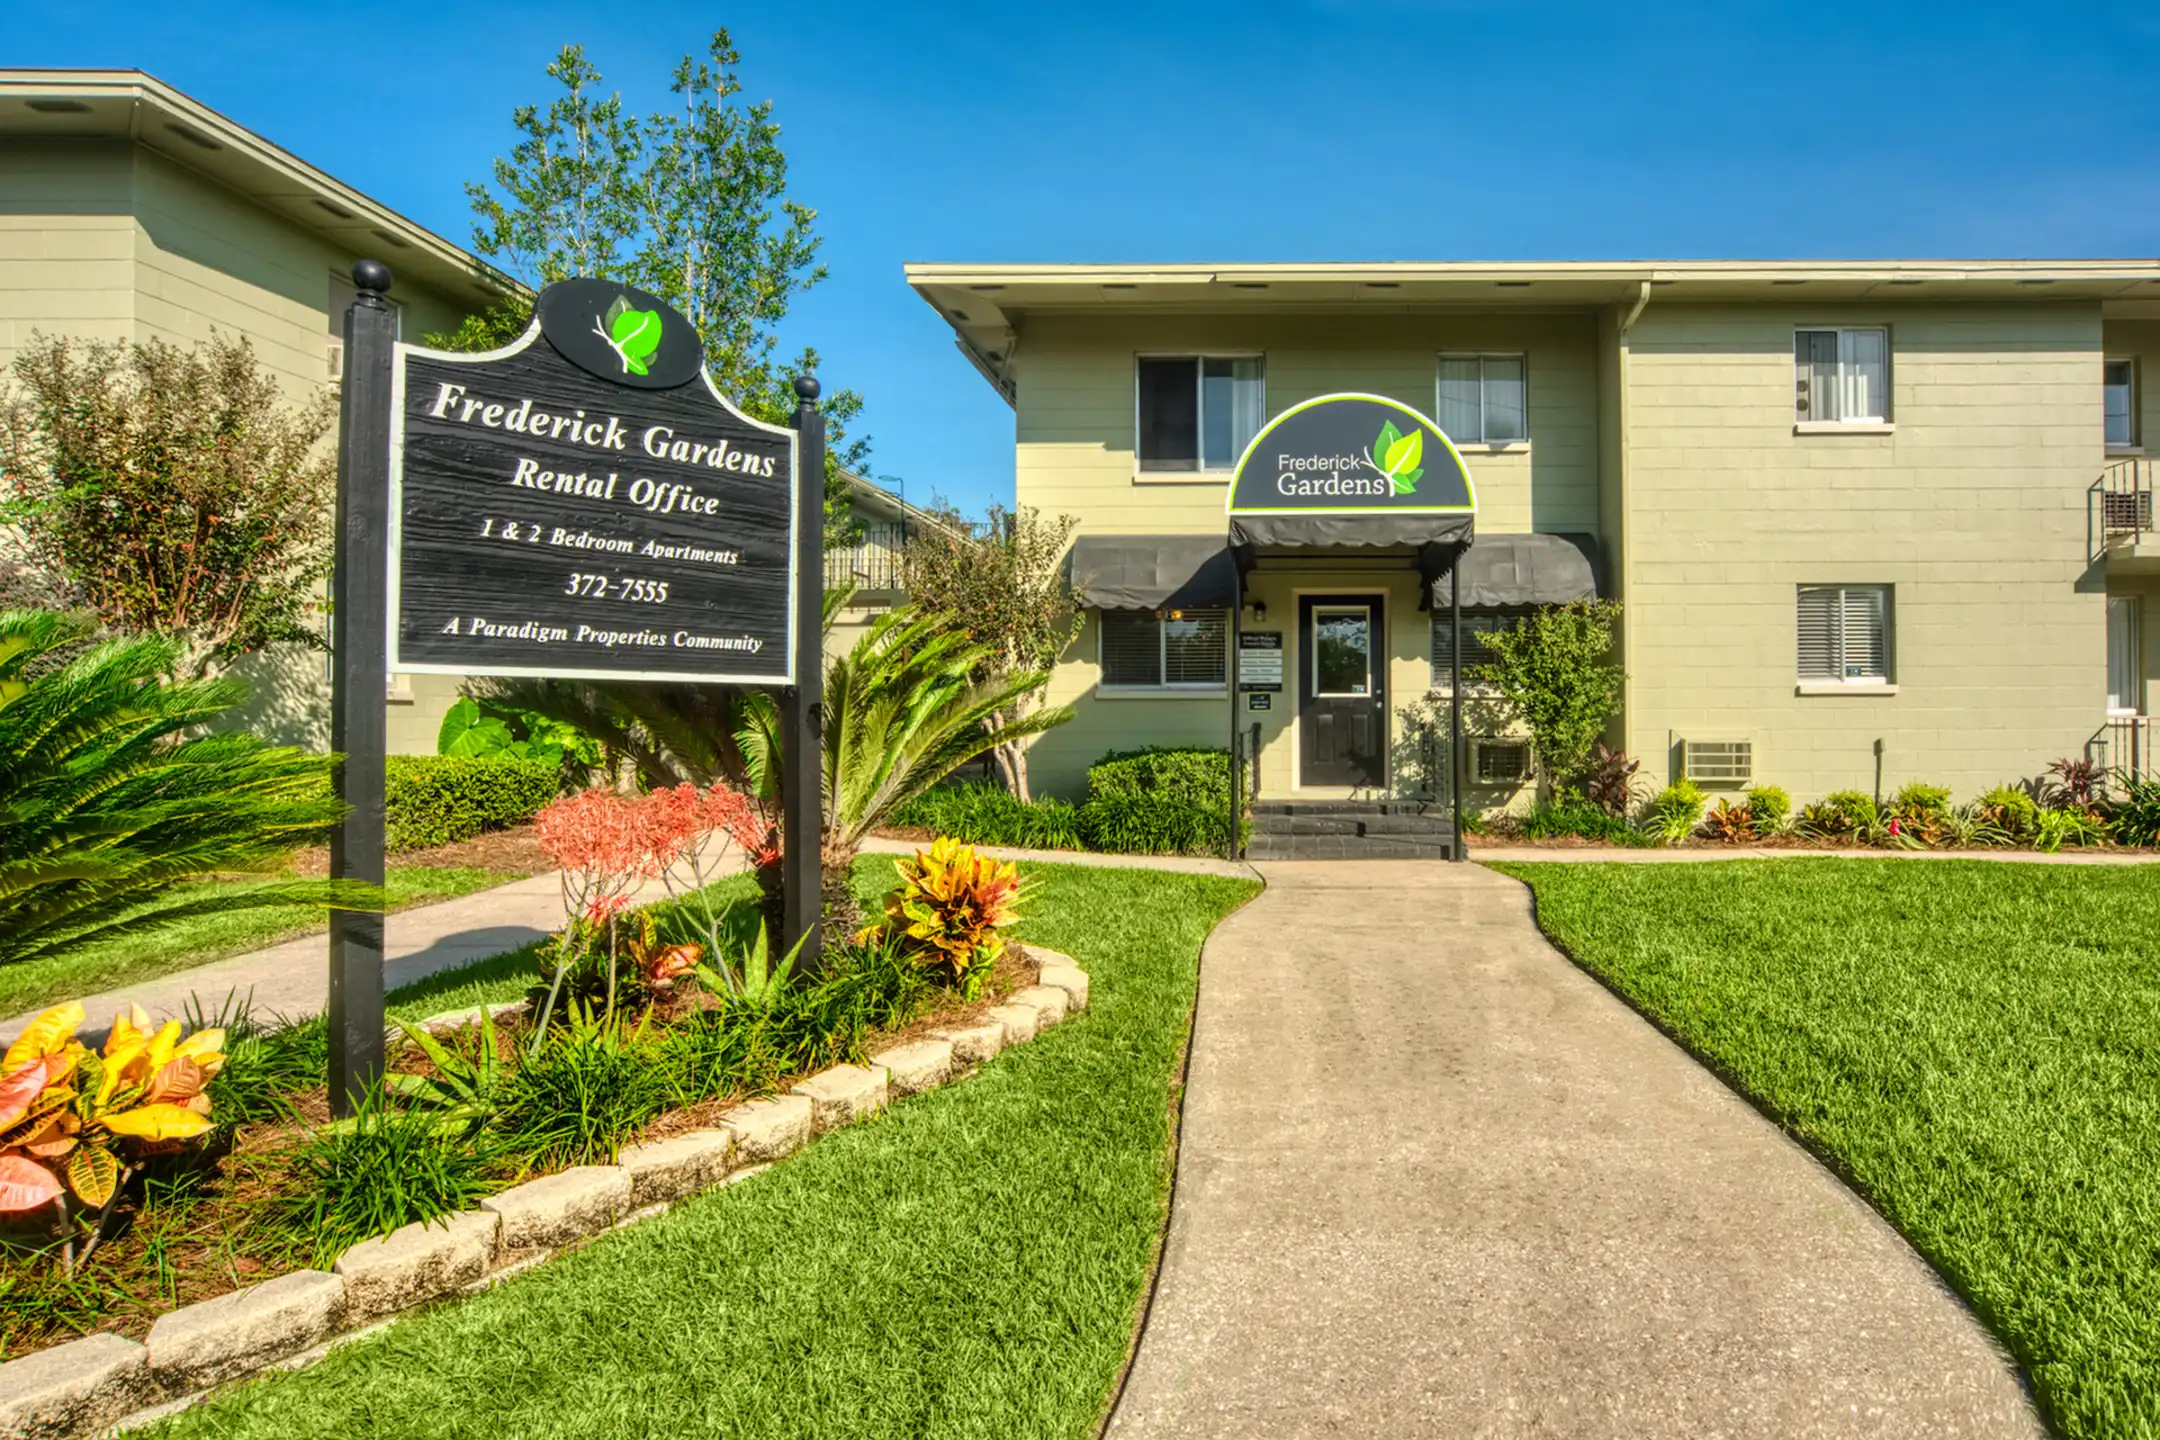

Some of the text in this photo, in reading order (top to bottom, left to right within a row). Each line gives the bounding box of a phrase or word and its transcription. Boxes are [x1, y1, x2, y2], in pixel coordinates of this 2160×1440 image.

[429, 382, 776, 478] Frederick Gardens
[1278, 453, 1361, 471] Frederick
[510, 458, 720, 515] Rental Office
[1277, 471, 1385, 496] Gardens
[480, 518, 739, 565] 1 & 2 Bedroom Apartments
[564, 572, 669, 604] 372-7555
[441, 616, 763, 654] A Paradigm Properties Community
